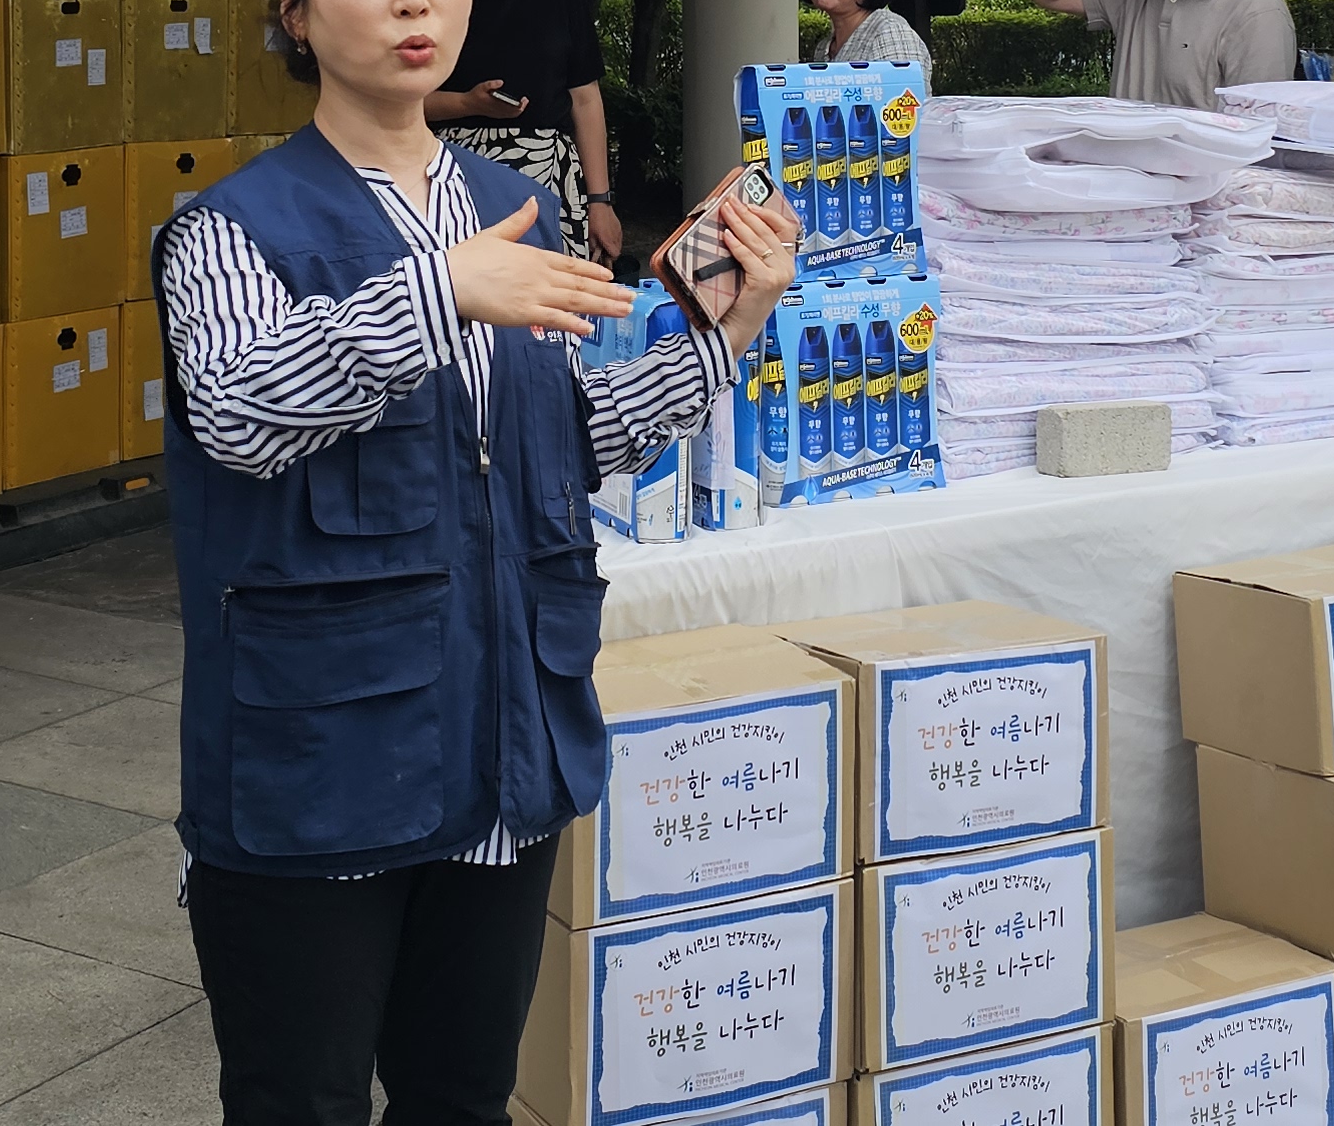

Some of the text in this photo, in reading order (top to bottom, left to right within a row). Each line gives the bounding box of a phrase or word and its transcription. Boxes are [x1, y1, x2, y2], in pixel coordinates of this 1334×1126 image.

[843, 87, 862, 102] 수성
[863, 86, 883, 101] 무향
[861, 302, 880, 318] 수성
[881, 301, 901, 317] 무향
[823, 468, 858, 487] AQUA-BASE
[938, 687, 958, 708] 인천
[962, 678, 991, 695] 시민의
[664, 739, 688, 761] 인천
[692, 727, 725, 747] 시민의
[918, 713, 1059, 750] 건강한 여름나기
[640, 757, 798, 805] 건강한 여름나기
[929, 754, 1049, 791] 행복을 나누다
[653, 802, 788, 847] 행복을 나누다
[943, 889, 963, 911] 인천
[968, 878, 997, 897] 시민의
[922, 906, 1063, 953] 건강한 여름나기
[658, 948, 682, 971] 인천
[686, 935, 719, 956] 시민의
[934, 949, 1055, 993] 행복을 나누다
[634, 964, 795, 1016] 건강한 여름나기
[647, 1009, 784, 1057] 행복을 나누다
[1179, 1046, 1304, 1096] 건강한 여름나기
[937, 1091, 958, 1113] 인천
[962, 1078, 992, 1098] 시민의
[1247, 1088, 1297, 1116] 나누다
